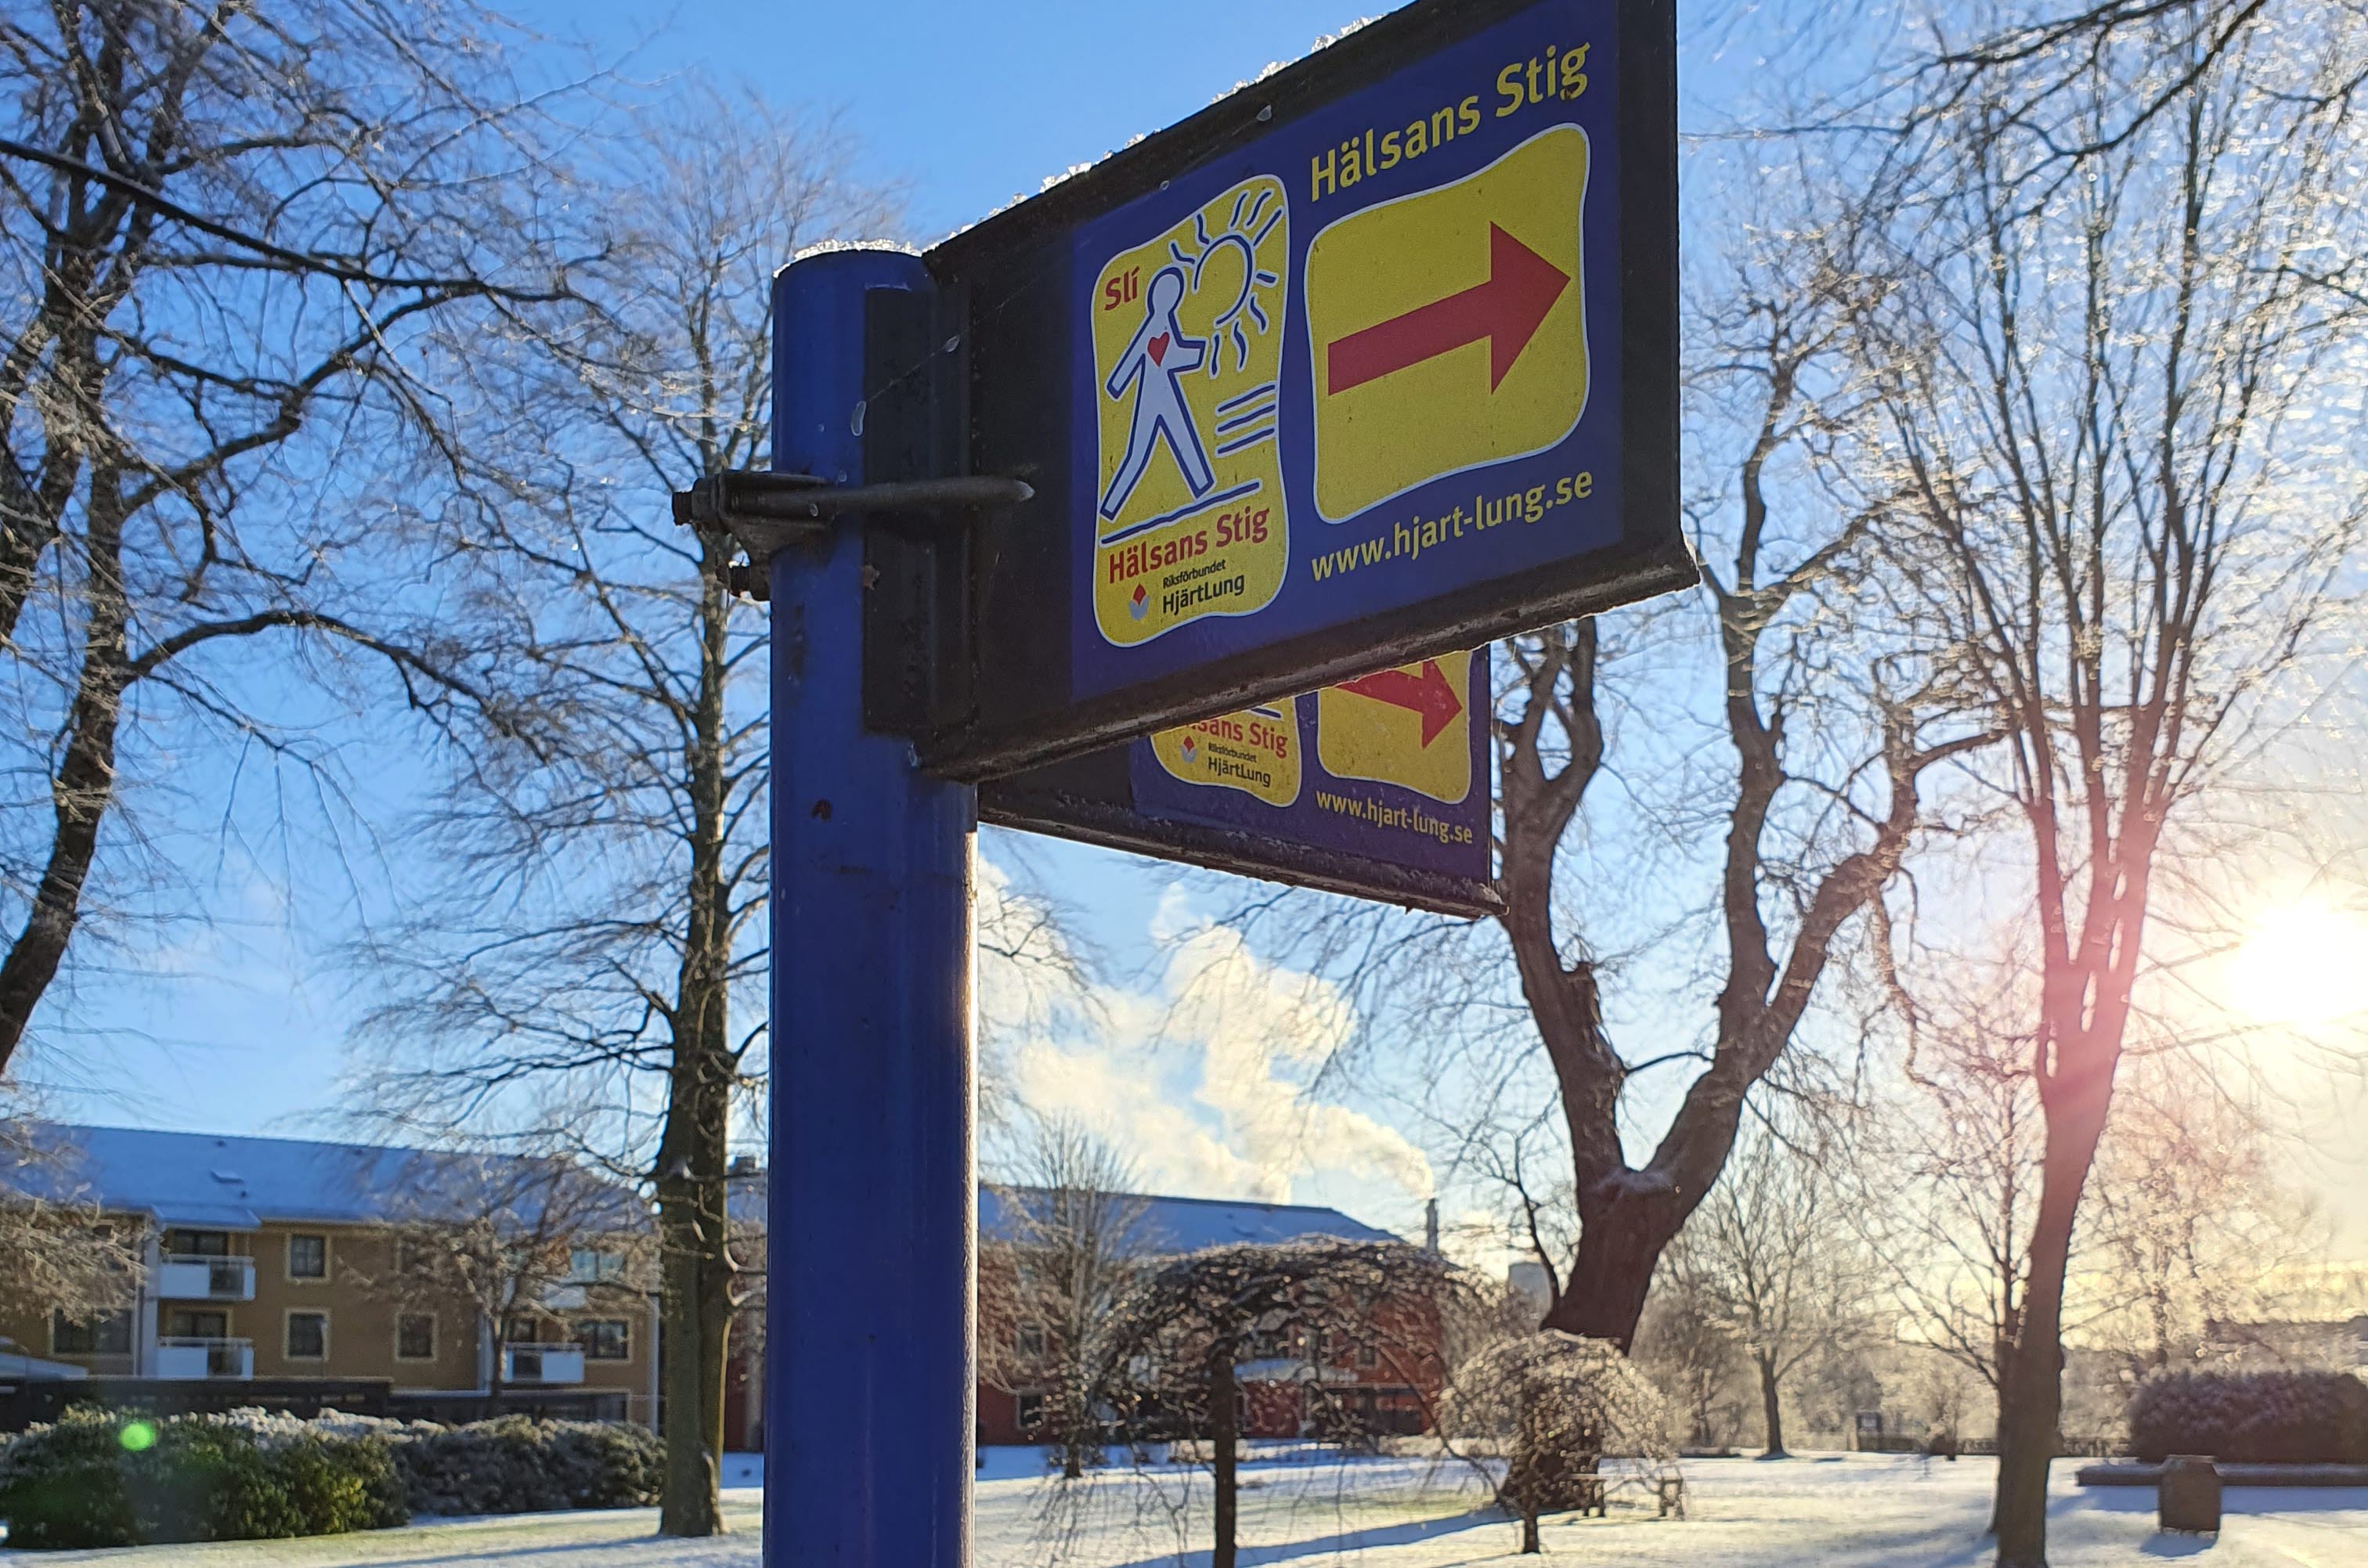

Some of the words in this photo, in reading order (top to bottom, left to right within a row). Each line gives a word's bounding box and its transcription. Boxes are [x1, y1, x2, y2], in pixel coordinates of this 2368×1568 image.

[1311, 95, 1481, 202] Hälsans
[1495, 42, 1590, 117] Stig
[1109, 530, 1207, 584] Hälsans
[1216, 506, 1270, 549] Stig
[1311, 470, 1593, 582] www.hjart-lung.se
[1162, 559, 1226, 589] Riksförbundet
[1162, 575, 1245, 615] HjärtLung
[1249, 722, 1288, 759] Stig
[1207, 756, 1271, 788] HjärtLung
[1316, 789, 1473, 845] www.hjart-lung.se
